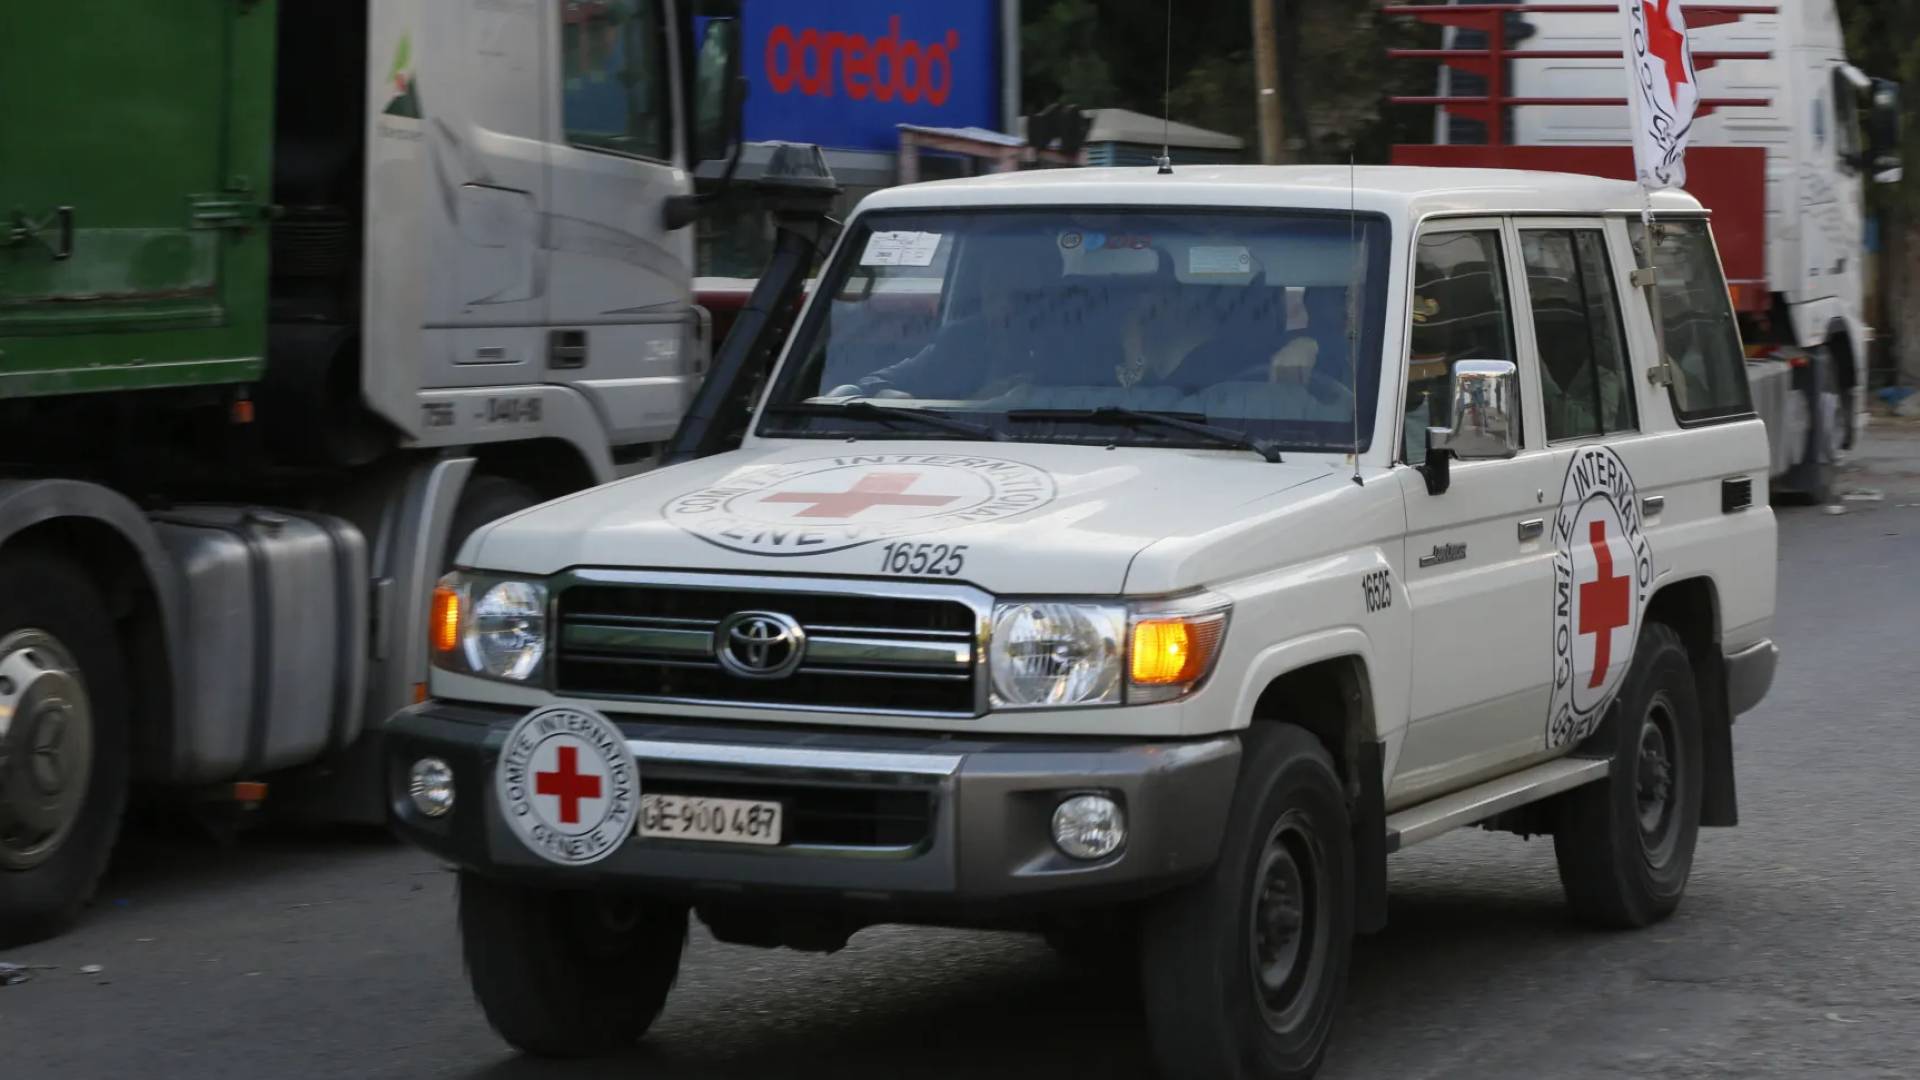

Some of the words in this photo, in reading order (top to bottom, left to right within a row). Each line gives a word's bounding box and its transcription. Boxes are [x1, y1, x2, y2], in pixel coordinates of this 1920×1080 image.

[1572, 451, 1651, 602] INTERNATIO
[881, 542, 969, 576] 16525
[1361, 569, 1392, 613] 16525
[505, 733, 534, 817] COMITE
[539, 714, 631, 824] INTERNATIONAL
[532, 823, 608, 857] GENEVE
